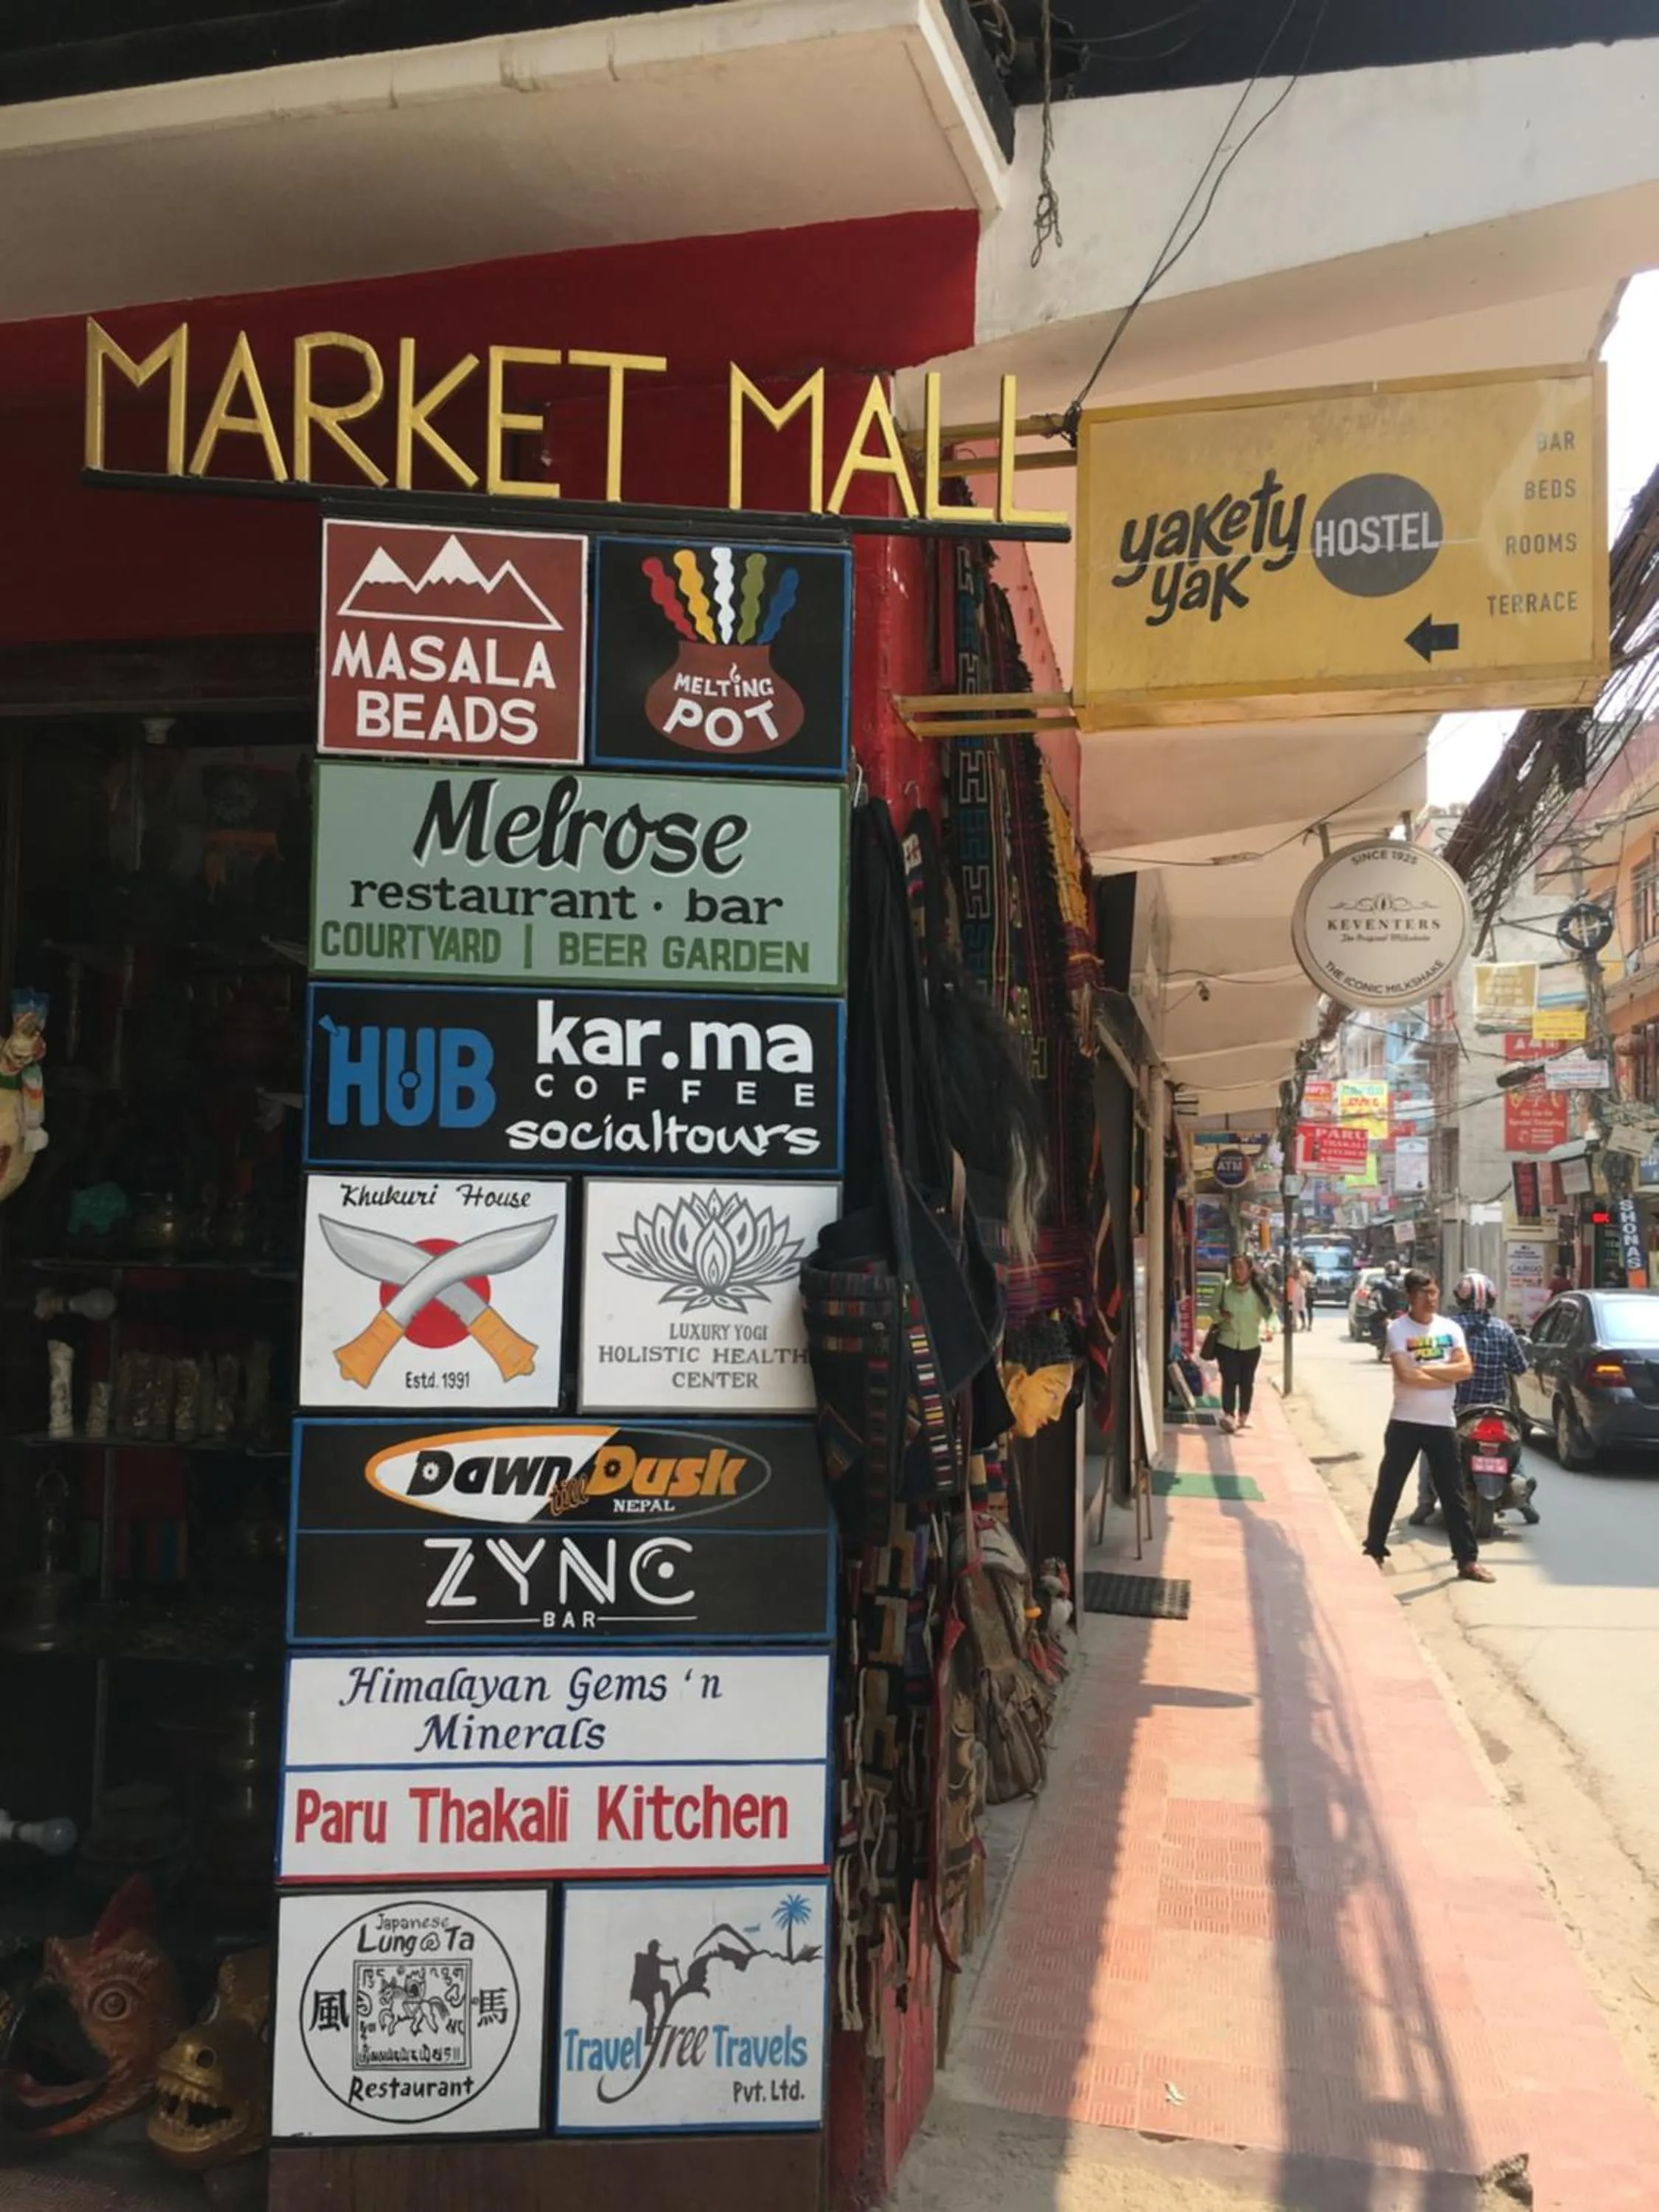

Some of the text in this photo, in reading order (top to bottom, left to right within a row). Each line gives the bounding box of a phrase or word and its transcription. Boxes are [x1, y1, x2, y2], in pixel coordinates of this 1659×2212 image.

[85, 315, 1068, 524] MARKET MALL
[1537, 431, 1575, 453] BAR
[1524, 479, 1576, 501] BEDS
[1111, 468, 1307, 587] yakety
[1315, 511, 1441, 558] HOSTEL
[1506, 533, 1577, 555] ROOMS
[1146, 555, 1250, 626] yak
[1487, 591, 1578, 616] TERRACE
[332, 630, 556, 689] MASALA
[357, 690, 538, 745] BEADS
[663, 699, 779, 748] POT
[411, 774, 750, 876] Melrose
[1351, 850, 1387, 866] SINCE
[349, 877, 783, 925] restaurant bar
[1327, 919, 1441, 931] KEVENTERS
[321, 920, 809, 973] COURTYARD BEER GARDEN
[1325, 959, 1445, 995] THE ICONIC MILKSHAKE
[536, 999, 813, 1073] kar.ma
[324, 1024, 496, 1129] HUB
[535, 1073, 815, 1107] COFFEE
[505, 1109, 821, 1157] socialtours
[1217, 1160, 1242, 1171] ATM
[340, 1182, 531, 1208] Khukuri House
[1619, 1199, 1641, 1268] SHONAS
[669, 1324, 768, 1341] LUXURY YOGI
[599, 1346, 807, 1365] HOLISTIC HEALTH
[442, 1371, 470, 1389] 1991
[671, 1372, 759, 1390] CENTER
[406, 1450, 573, 1497] Dawn
[588, 1446, 747, 1497] Dusk
[613, 1499, 675, 1513] NEPAL
[423, 1537, 695, 1607] ZYNC
[543, 1611, 596, 1628] BAR
[339, 1666, 551, 1708] Himalayan
[567, 1666, 668, 1711] Gems
[414, 1712, 606, 1753] Minerals
[295, 1784, 788, 1843] Paru Thakali Kitchen
[358, 1924, 475, 1957] Lung Ta
[376, 1913, 449, 1933] Japanese
[309, 1989, 349, 2032] 風
[477, 1987, 509, 2027] 馬
[564, 2027, 642, 2072] Travel
[712, 2024, 807, 2067] Travels
[348, 2075, 475, 2104] Restaurant
[734, 2078, 805, 2104] Pvt. Ltd.
